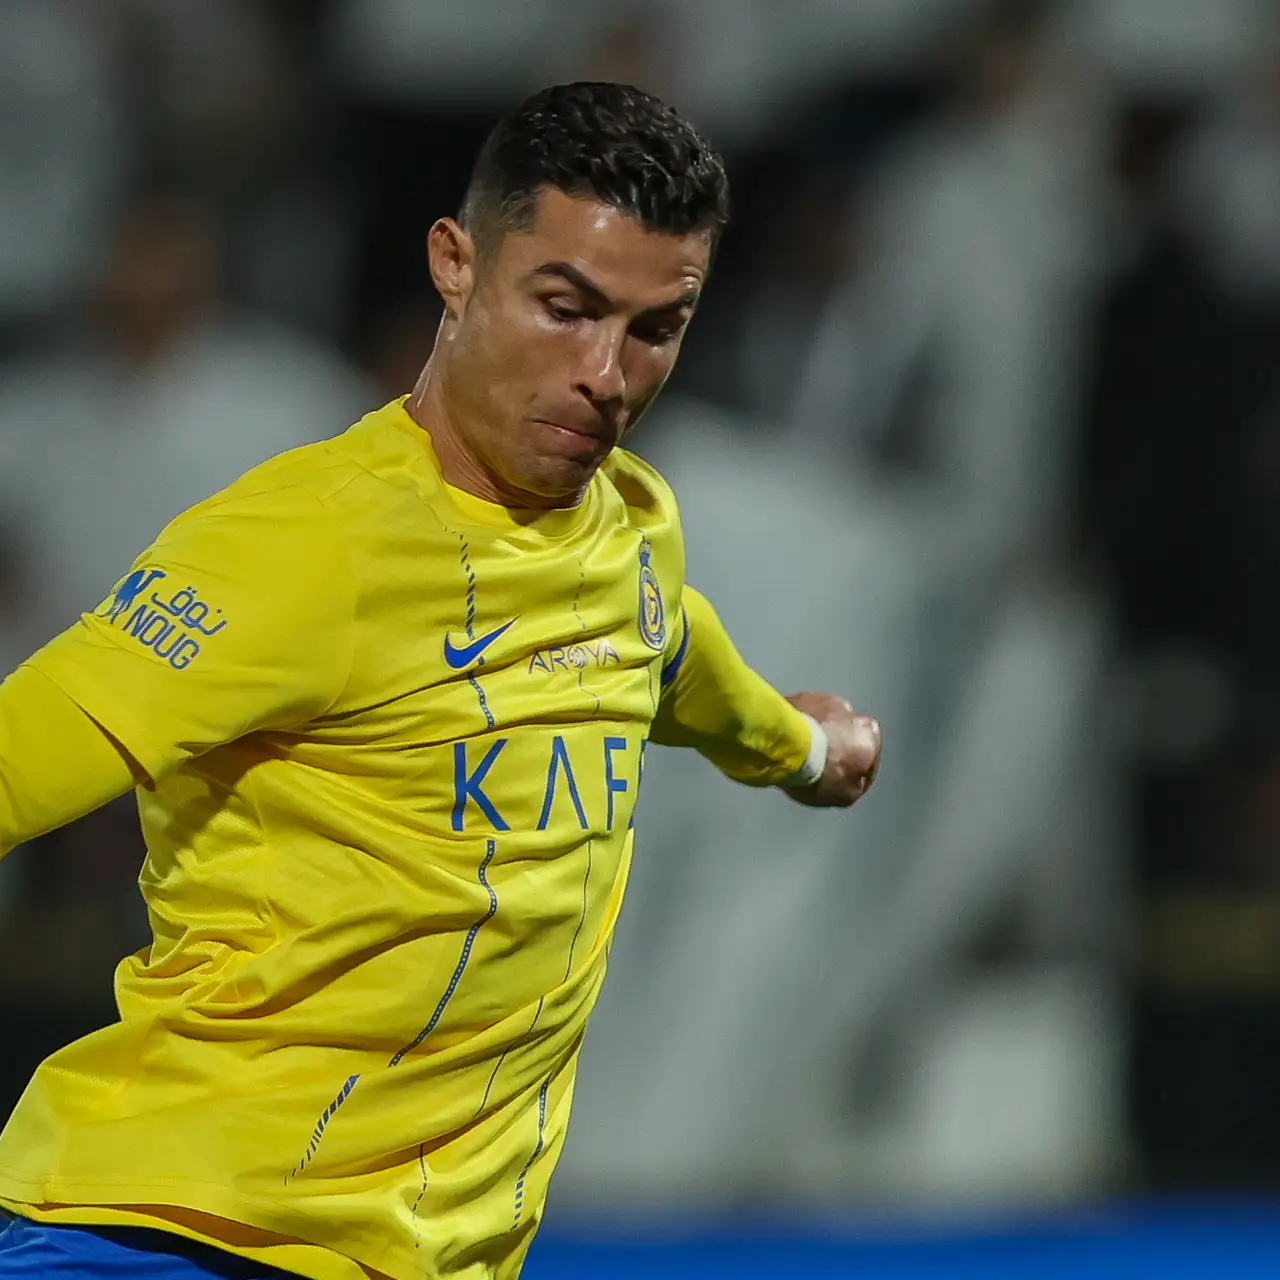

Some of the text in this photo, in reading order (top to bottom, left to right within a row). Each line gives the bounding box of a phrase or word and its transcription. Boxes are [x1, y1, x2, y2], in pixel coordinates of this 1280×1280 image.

[122, 604, 200, 670] NOUG
[528, 643, 620, 675] AROYA
[450, 735, 648, 832] KAF
